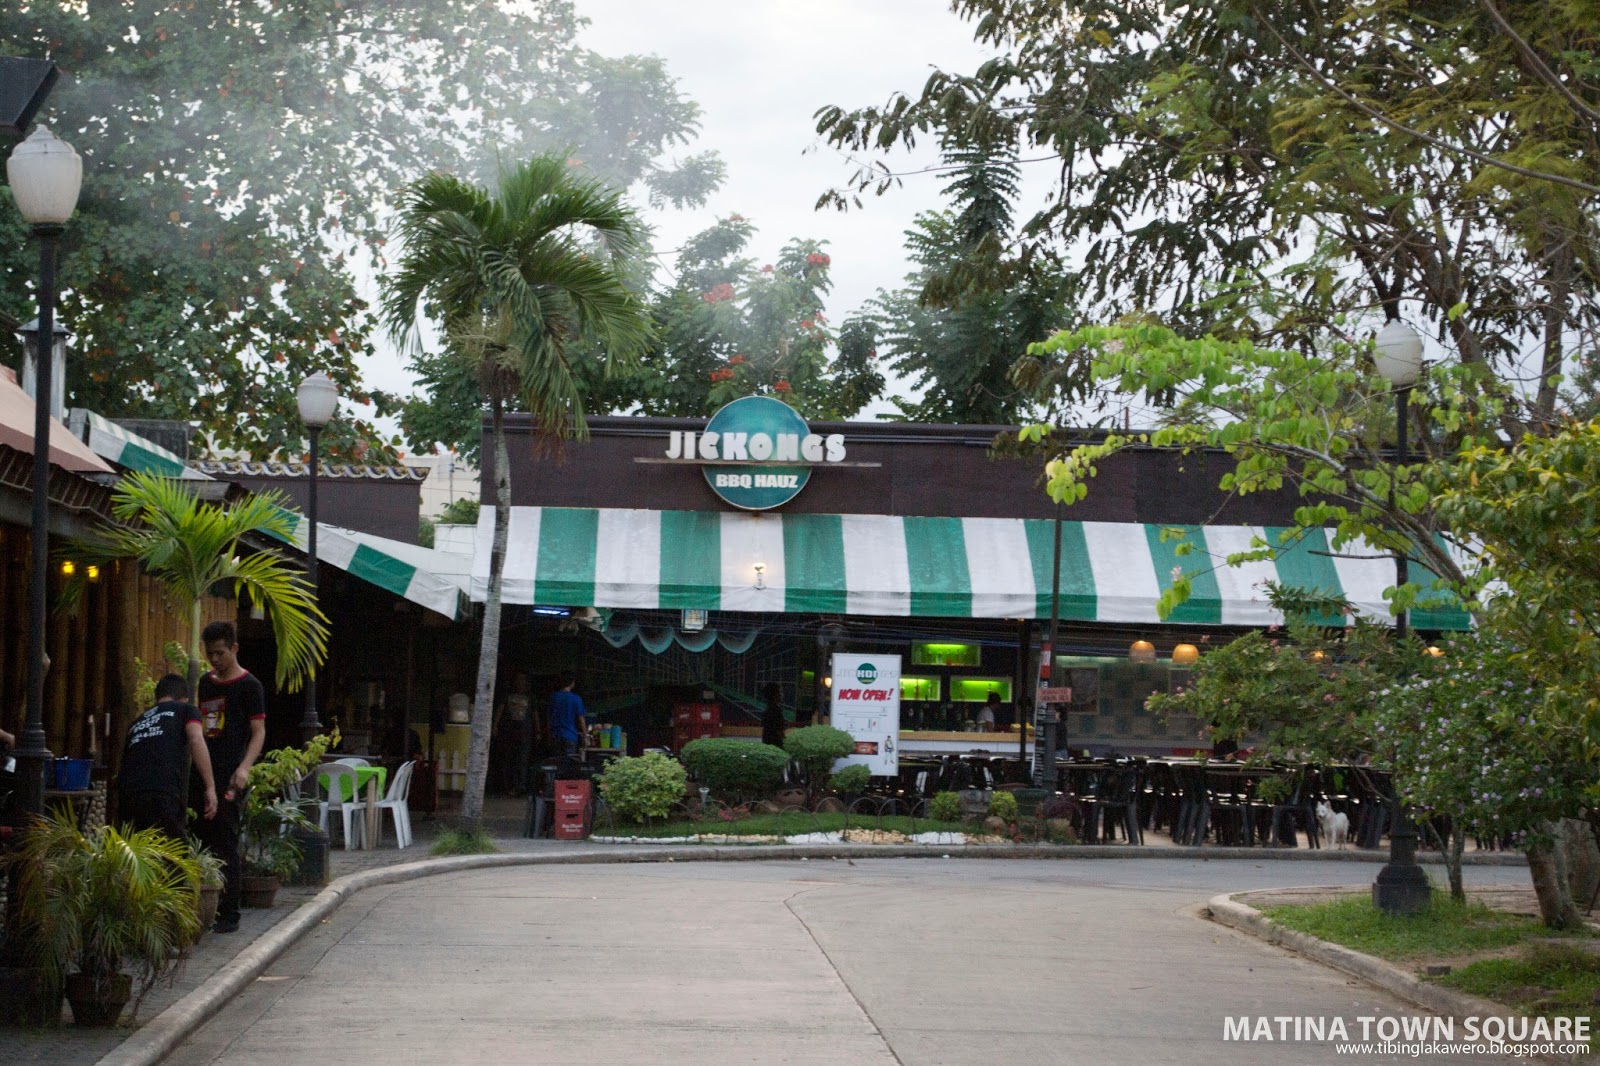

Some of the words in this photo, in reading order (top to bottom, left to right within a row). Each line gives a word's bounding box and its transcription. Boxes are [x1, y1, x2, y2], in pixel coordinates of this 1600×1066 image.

[665, 431, 847, 462] JICKONGS
[715, 474, 752, 489] BBQ
[754, 474, 799, 489] HAUZ
[838, 689, 861, 700] NOW
[862, 688, 893, 701] OPEN!
